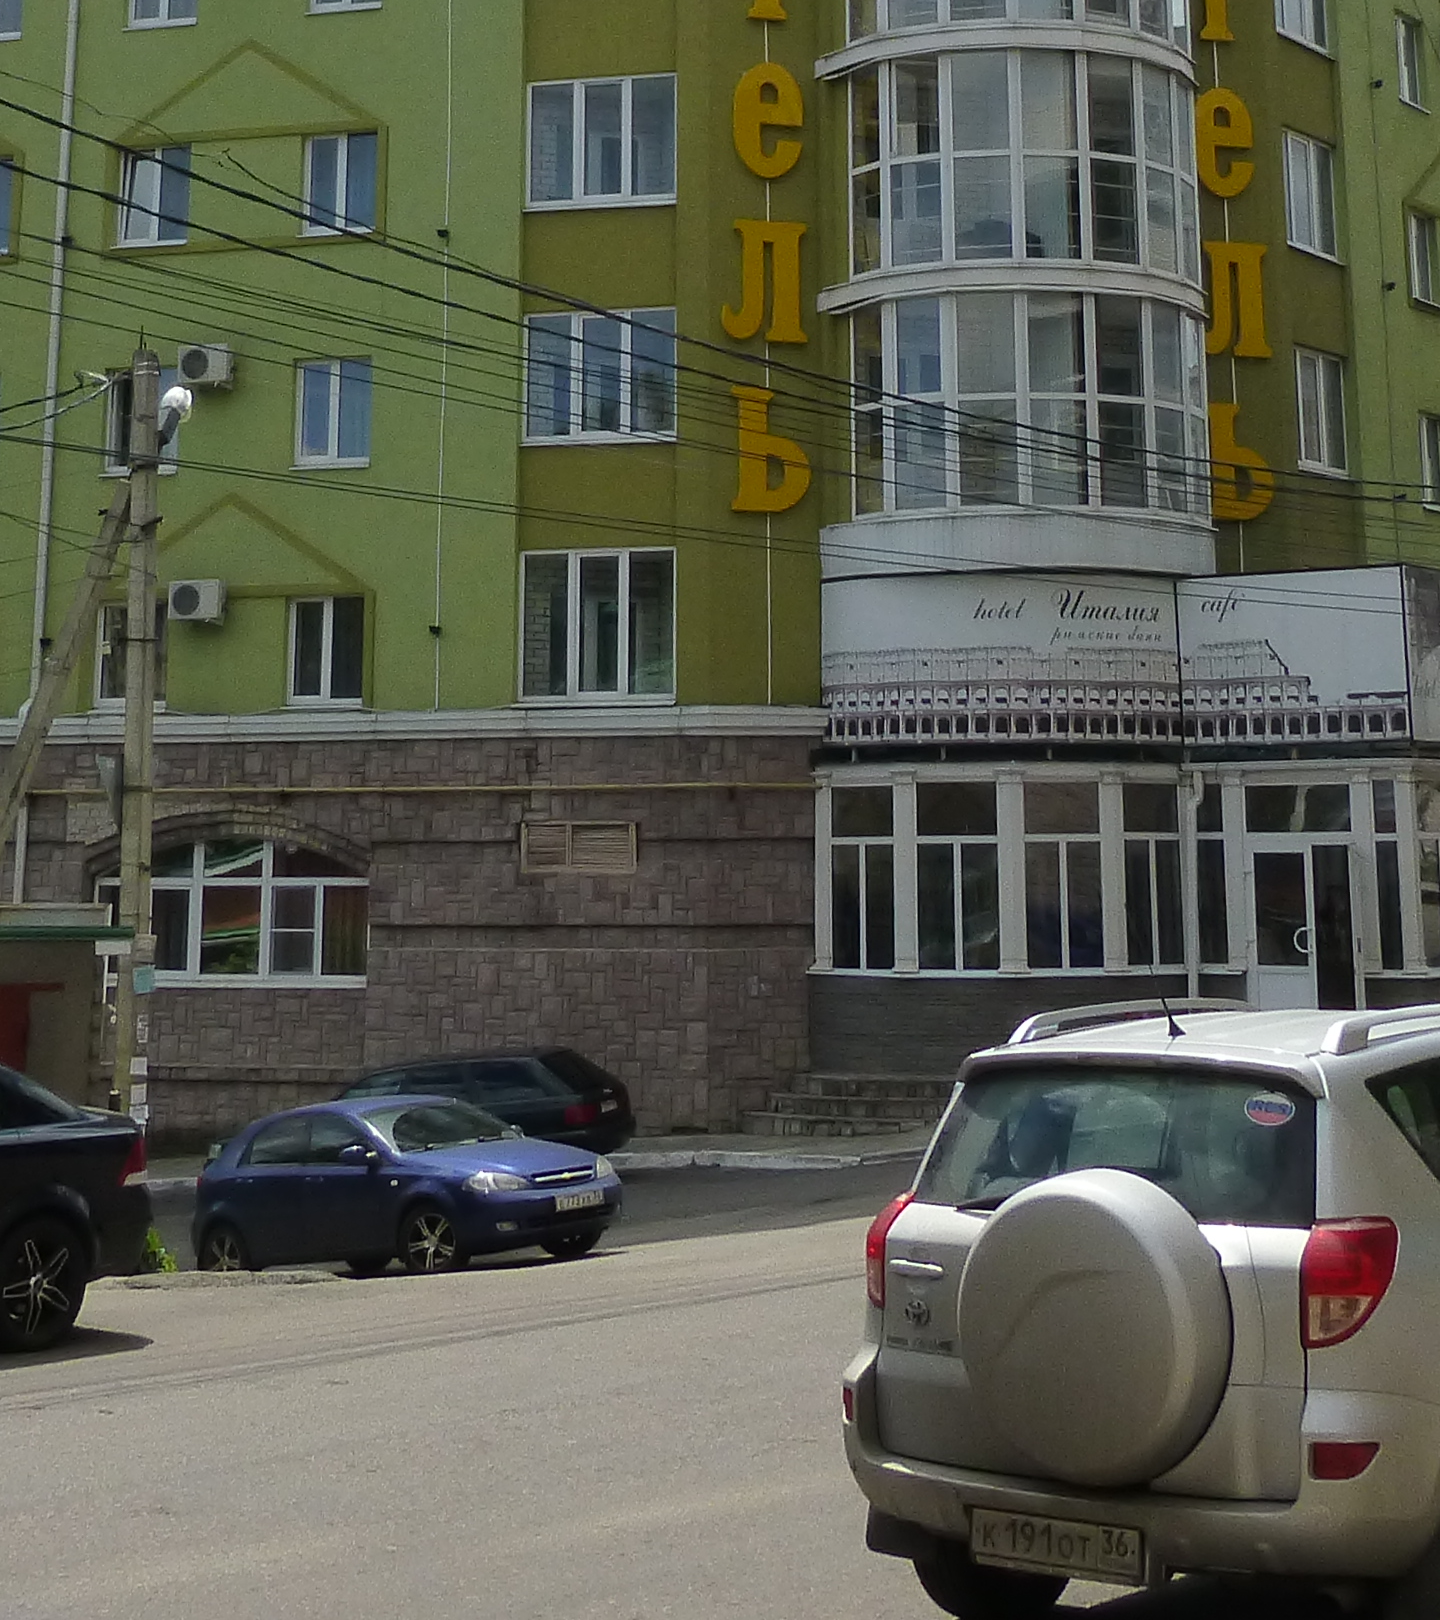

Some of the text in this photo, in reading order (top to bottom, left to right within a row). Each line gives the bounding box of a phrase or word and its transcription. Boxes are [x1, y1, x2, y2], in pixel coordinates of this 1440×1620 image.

[973, 598, 1026, 620] hotel
[1051, 588, 1161, 624] Италия
[1101, 1529, 1129, 1557] 36
